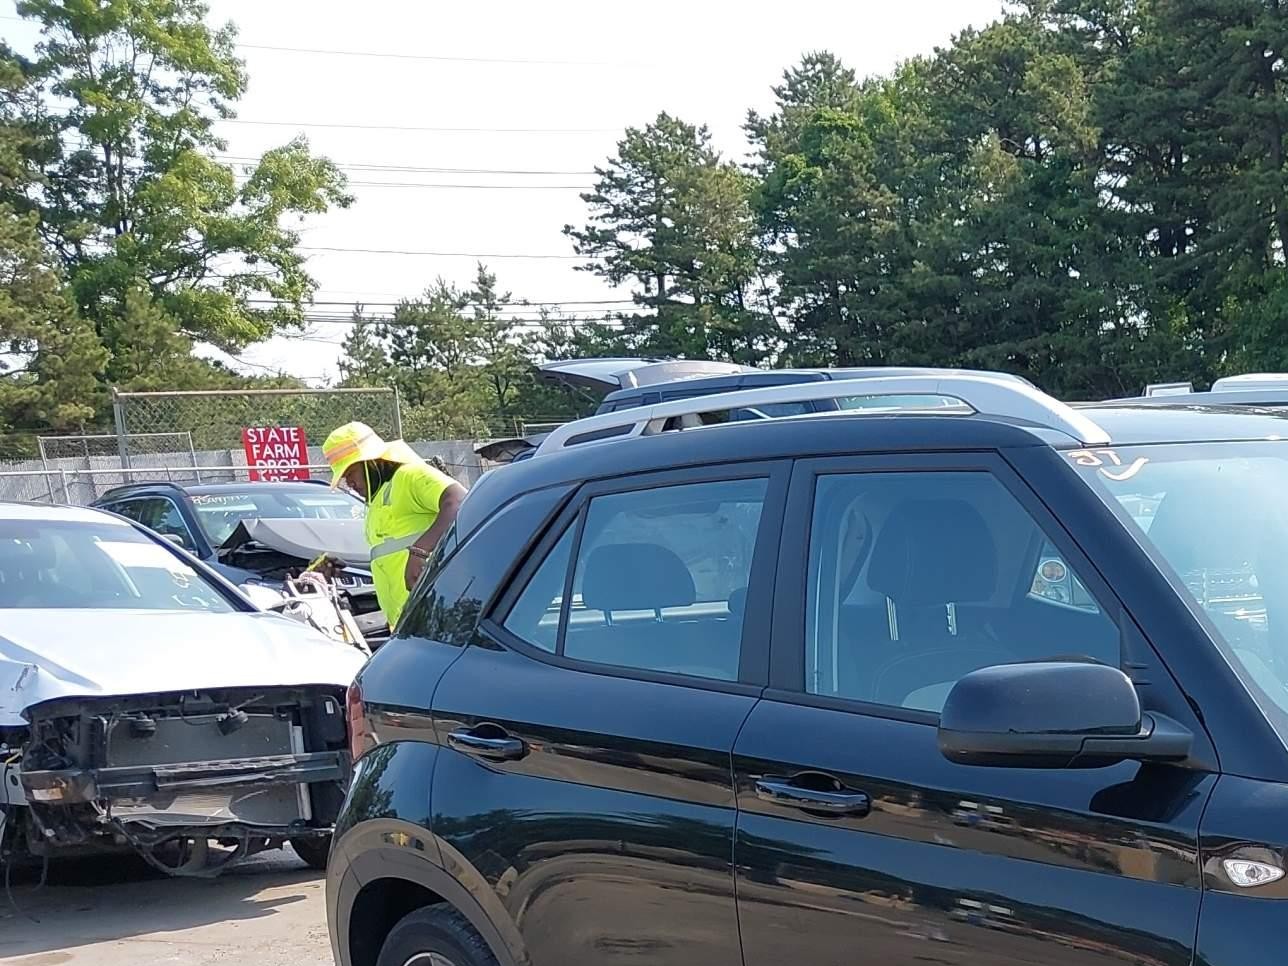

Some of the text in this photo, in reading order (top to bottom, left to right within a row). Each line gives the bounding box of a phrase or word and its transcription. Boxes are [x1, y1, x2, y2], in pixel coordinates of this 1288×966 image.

[247, 427, 300, 443] STATE
[252, 443, 300, 459] FARM
[255, 459, 300, 475] DROP
